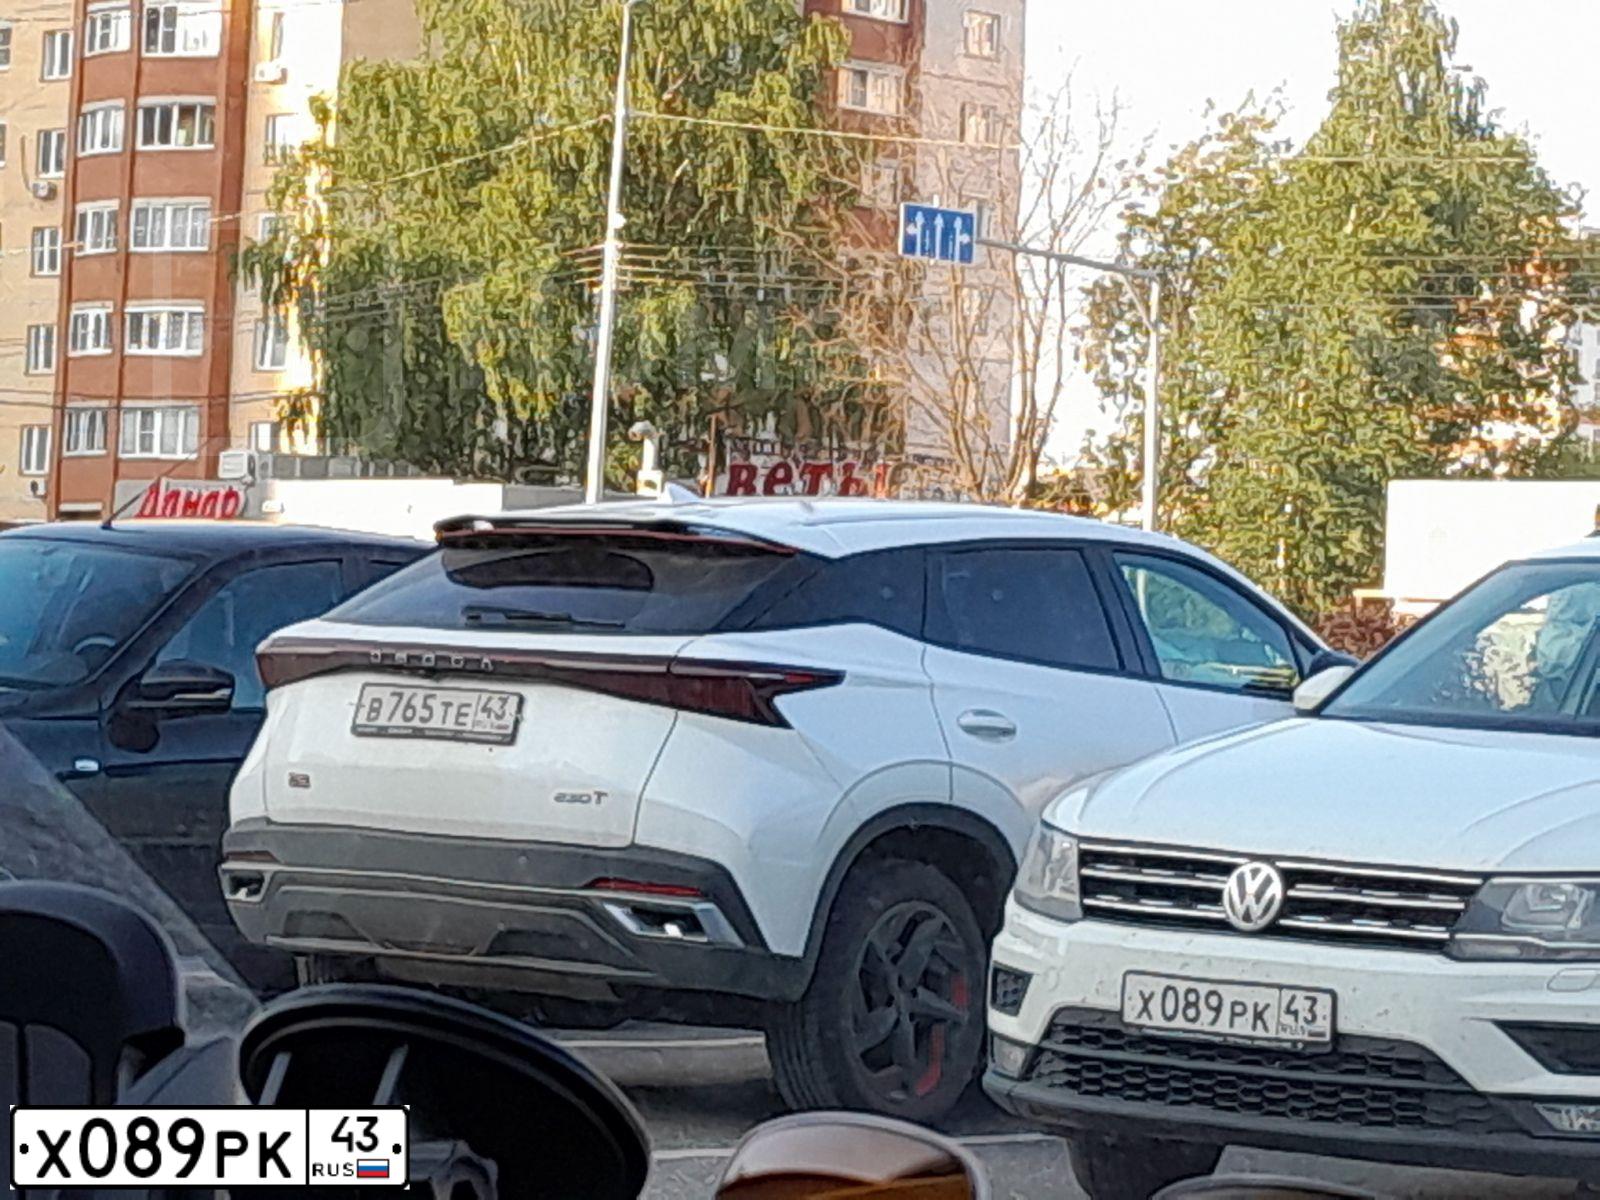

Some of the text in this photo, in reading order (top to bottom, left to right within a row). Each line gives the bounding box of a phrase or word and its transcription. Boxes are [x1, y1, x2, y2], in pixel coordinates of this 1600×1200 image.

[480, 694, 510, 721] 43
[1135, 985, 1318, 1034] Х089РК 43
